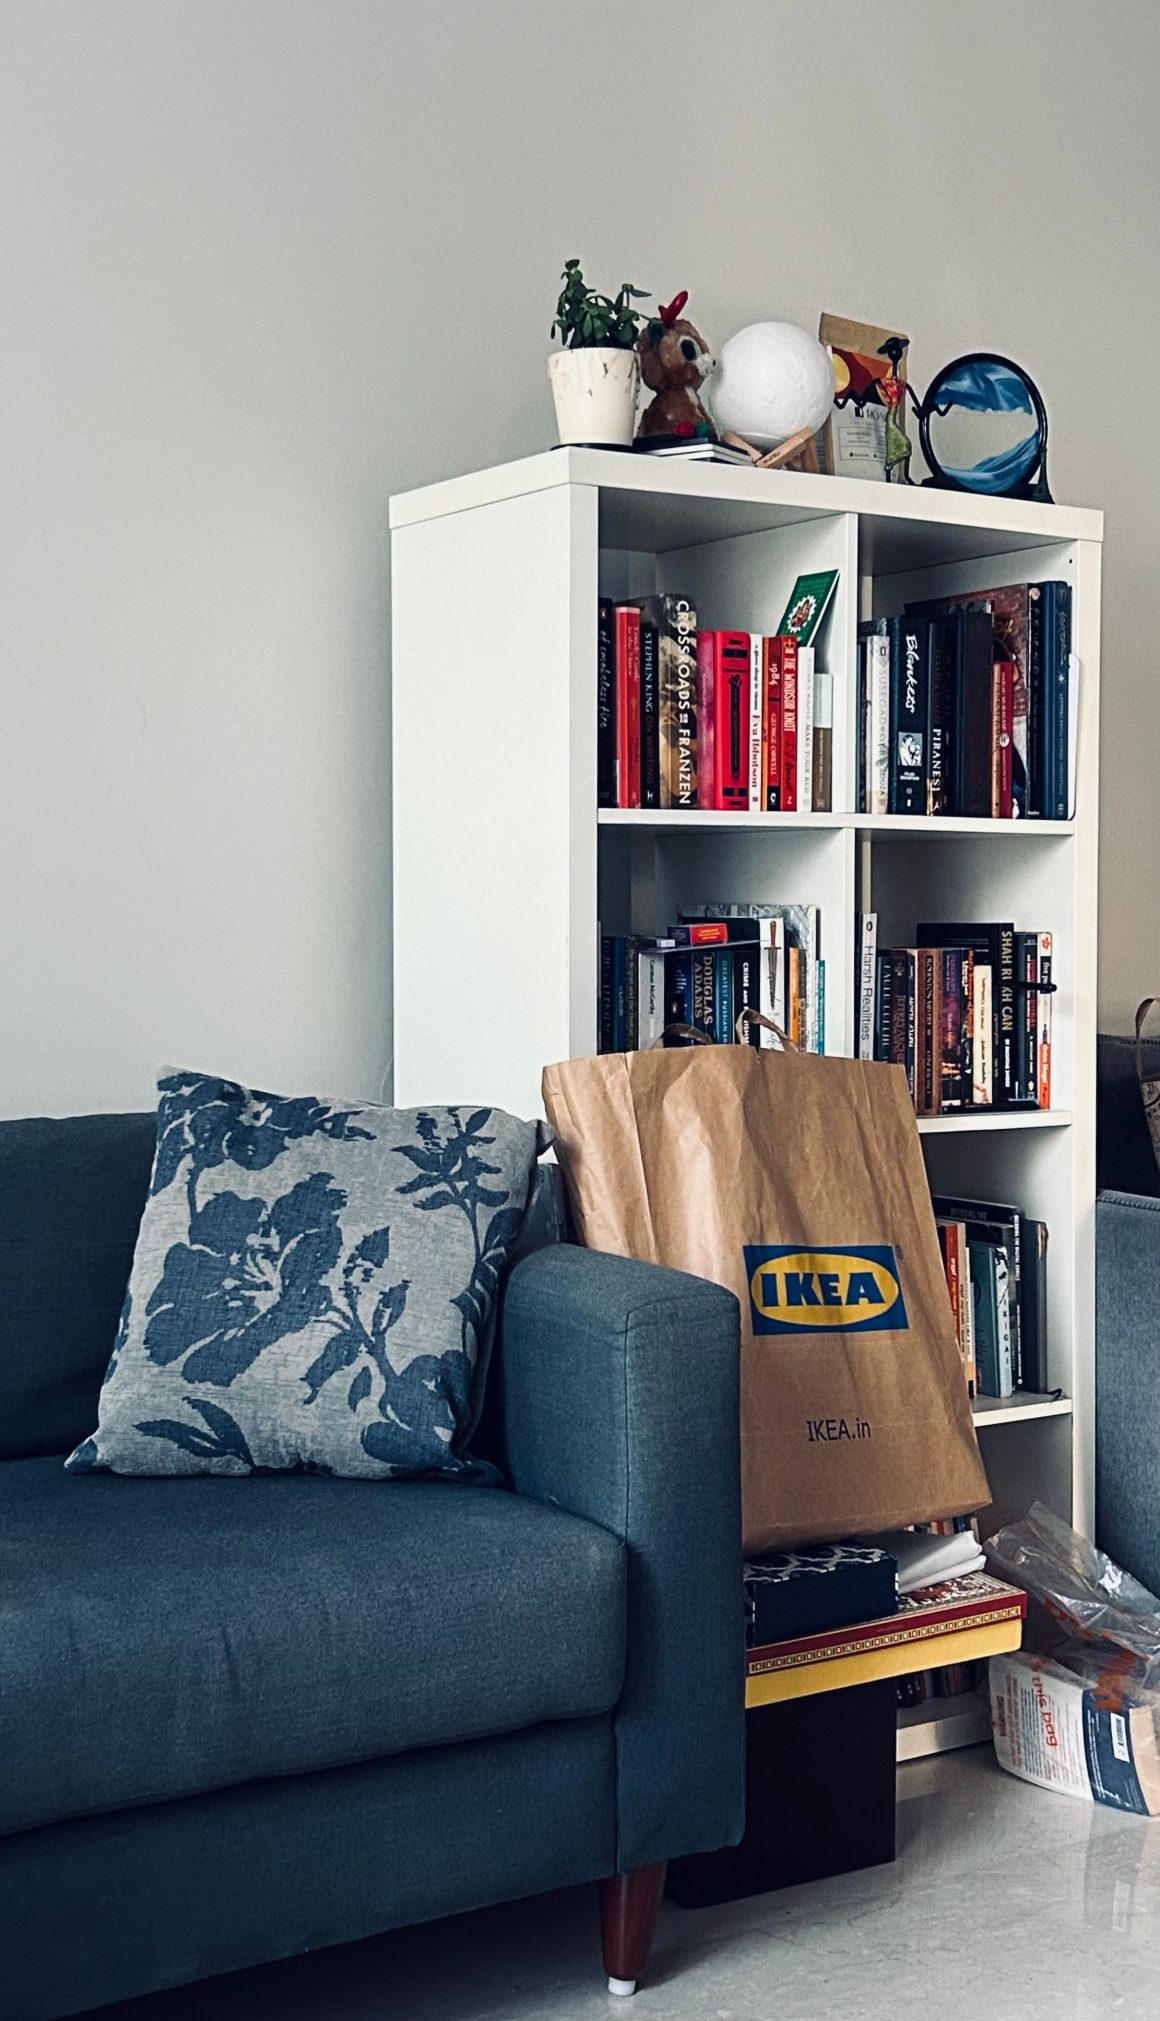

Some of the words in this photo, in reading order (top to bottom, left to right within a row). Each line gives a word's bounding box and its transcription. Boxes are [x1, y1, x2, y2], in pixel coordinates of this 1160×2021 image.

[600, 645, 611, 702] smokeless
[645, 632, 653, 681] STEPHEN
[678, 600, 691, 710] CROSSROADS
[769, 663, 780, 686] 1984
[784, 657, 796, 670] THE
[905, 634, 919, 713] Blankets
[645, 684, 653, 712] KING
[784, 673, 796, 710] WINDSOR
[600, 711, 611, 728] fire
[752, 714, 760, 735] Eva
[784, 711, 796, 733] KNOT
[678, 728, 691, 804] FRANZEN
[752, 738, 760, 788] Ibbotson
[932, 728, 942, 792] PIRANESI
[864, 945, 873, 984] Harsh
[1002, 931, 1013, 964] SHAH
[694, 962, 703, 1018] ADAMS
[703, 956, 713, 1025] DOUGLAS
[862, 988, 873, 1041] Realities
[1002, 1006, 1013, 1031] CAN
[760, 1272, 886, 1307] IKEA
[806, 1417, 871, 1442] IKEA.in
[1032, 1677, 1047, 1708] this
[1043, 1711, 1058, 1747] bag
